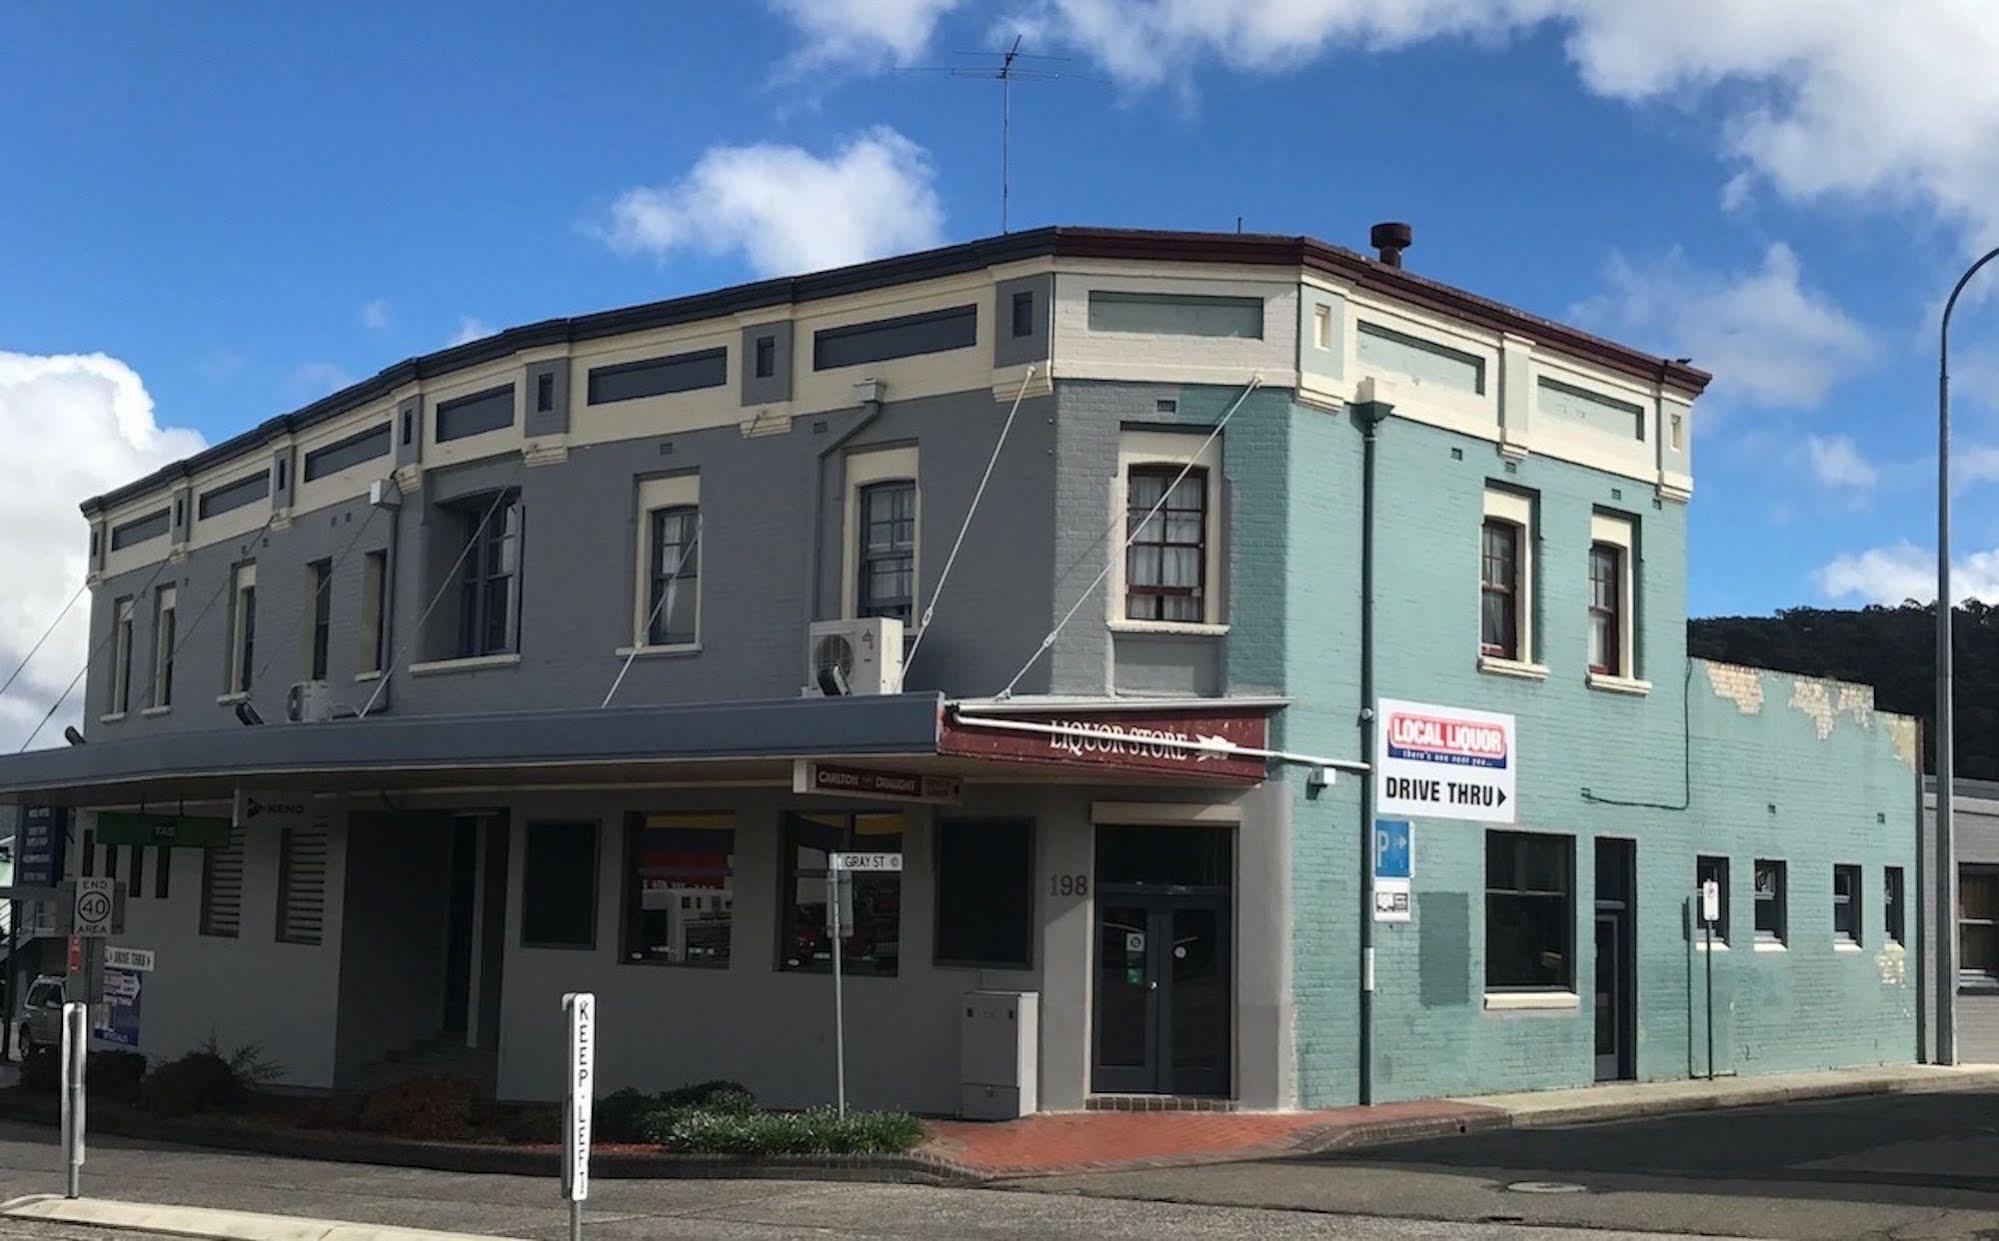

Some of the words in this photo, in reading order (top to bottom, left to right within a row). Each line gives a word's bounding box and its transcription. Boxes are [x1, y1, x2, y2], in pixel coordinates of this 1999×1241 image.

[1050, 719, 1126, 757] LIQUOR
[1127, 726, 1188, 761] STORE
[1393, 717, 1446, 747] LOCAL
[1445, 724, 1502, 753] LIQUOR
[819, 769, 859, 785] CARLTON
[876, 777, 916, 792] DRAUGHT
[1386, 776, 1440, 802] DRIVE
[1447, 781, 1493, 807] THRU
[268, 804, 303, 814] KENO
[1376, 830, 1390, 868] P
[845, 855, 871, 868] GRAY
[873, 855, 885, 868] ST
[83, 880, 107, 889] END
[1049, 874, 1088, 896] 198
[82, 899, 106, 915] 40
[77, 925, 107, 934] AREA
[579, 1001, 589, 1087] KEEP
